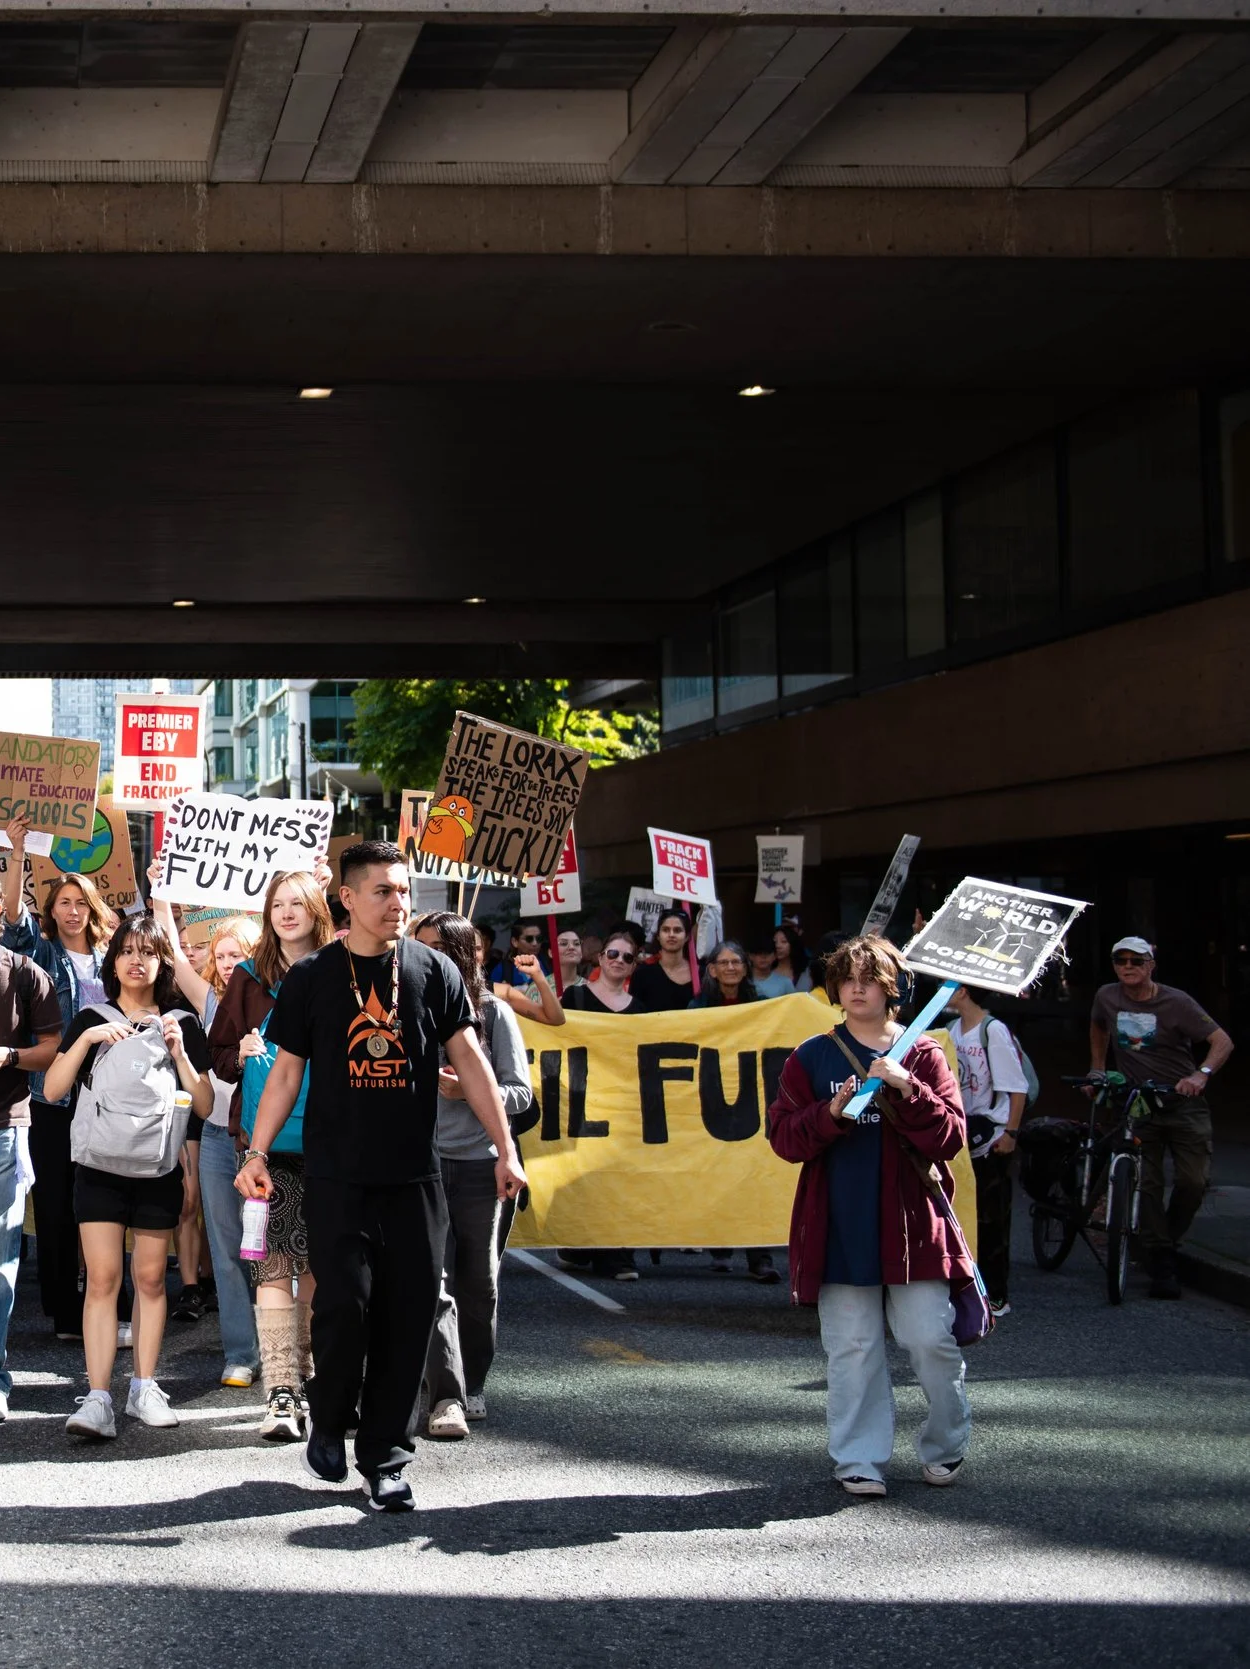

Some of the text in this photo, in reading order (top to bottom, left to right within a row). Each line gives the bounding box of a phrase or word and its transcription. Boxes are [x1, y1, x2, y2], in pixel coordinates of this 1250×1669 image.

[128, 712, 193, 730] PREMIER
[141, 731, 178, 752] EBY
[454, 716, 583, 787] THE LORAX
[140, 763, 177, 782] END
[445, 757, 499, 782] SPEAKS
[499, 767, 528, 792] FOR
[29, 784, 96, 801] EDUCATION
[123, 785, 193, 800] FRACKIN
[444, 776, 574, 836] THE TREES SAY
[181, 804, 321, 848] DON'T MESS
[174, 833, 278, 863] WITH MY
[467, 810, 538, 876] FUCK
[536, 834, 562, 876] U
[659, 839, 702, 861] FRACK
[667, 853, 698, 873] FREE
[536, 879, 565, 905] BC
[672, 872, 698, 895] BC
[116, 891, 137, 907] OUT
[970, 890, 1053, 918] ANOTHER
[957, 911, 973, 921] IS
[921, 956, 1007, 981] GO BEYOND GAS
[923, 940, 1025, 977] POSSIBLE
[967, 1046, 983, 1058] DIE
[348, 1059, 407, 1077] MST
[350, 1079, 406, 1088] FUTURISM
